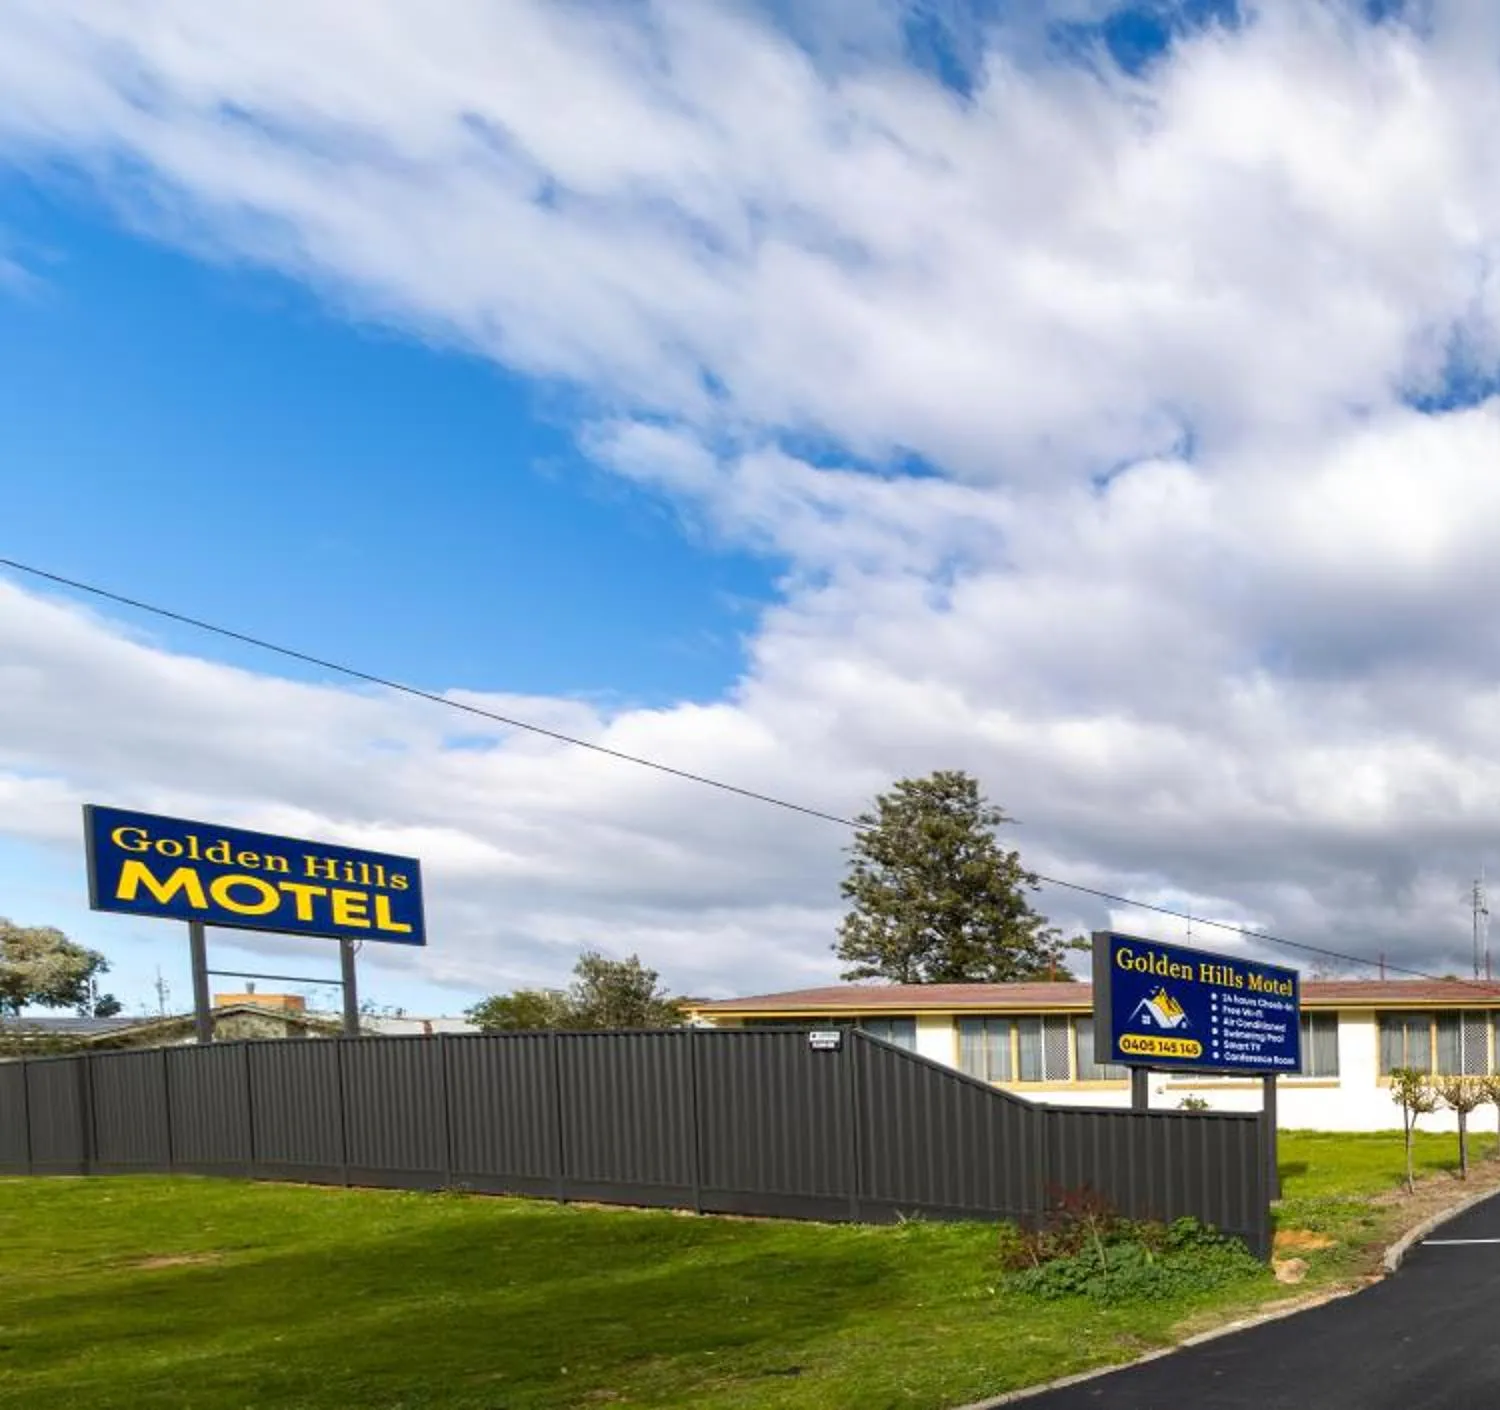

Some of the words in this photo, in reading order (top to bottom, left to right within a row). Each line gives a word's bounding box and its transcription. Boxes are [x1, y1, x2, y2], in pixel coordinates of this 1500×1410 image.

[111, 826, 291, 874] Golden
[303, 855, 408, 890] Hills
[115, 859, 412, 933] MOTEL
[1116, 947, 1193, 981] Golden
[1199, 963, 1243, 989] Hills
[1248, 973, 1293, 997] Motel
